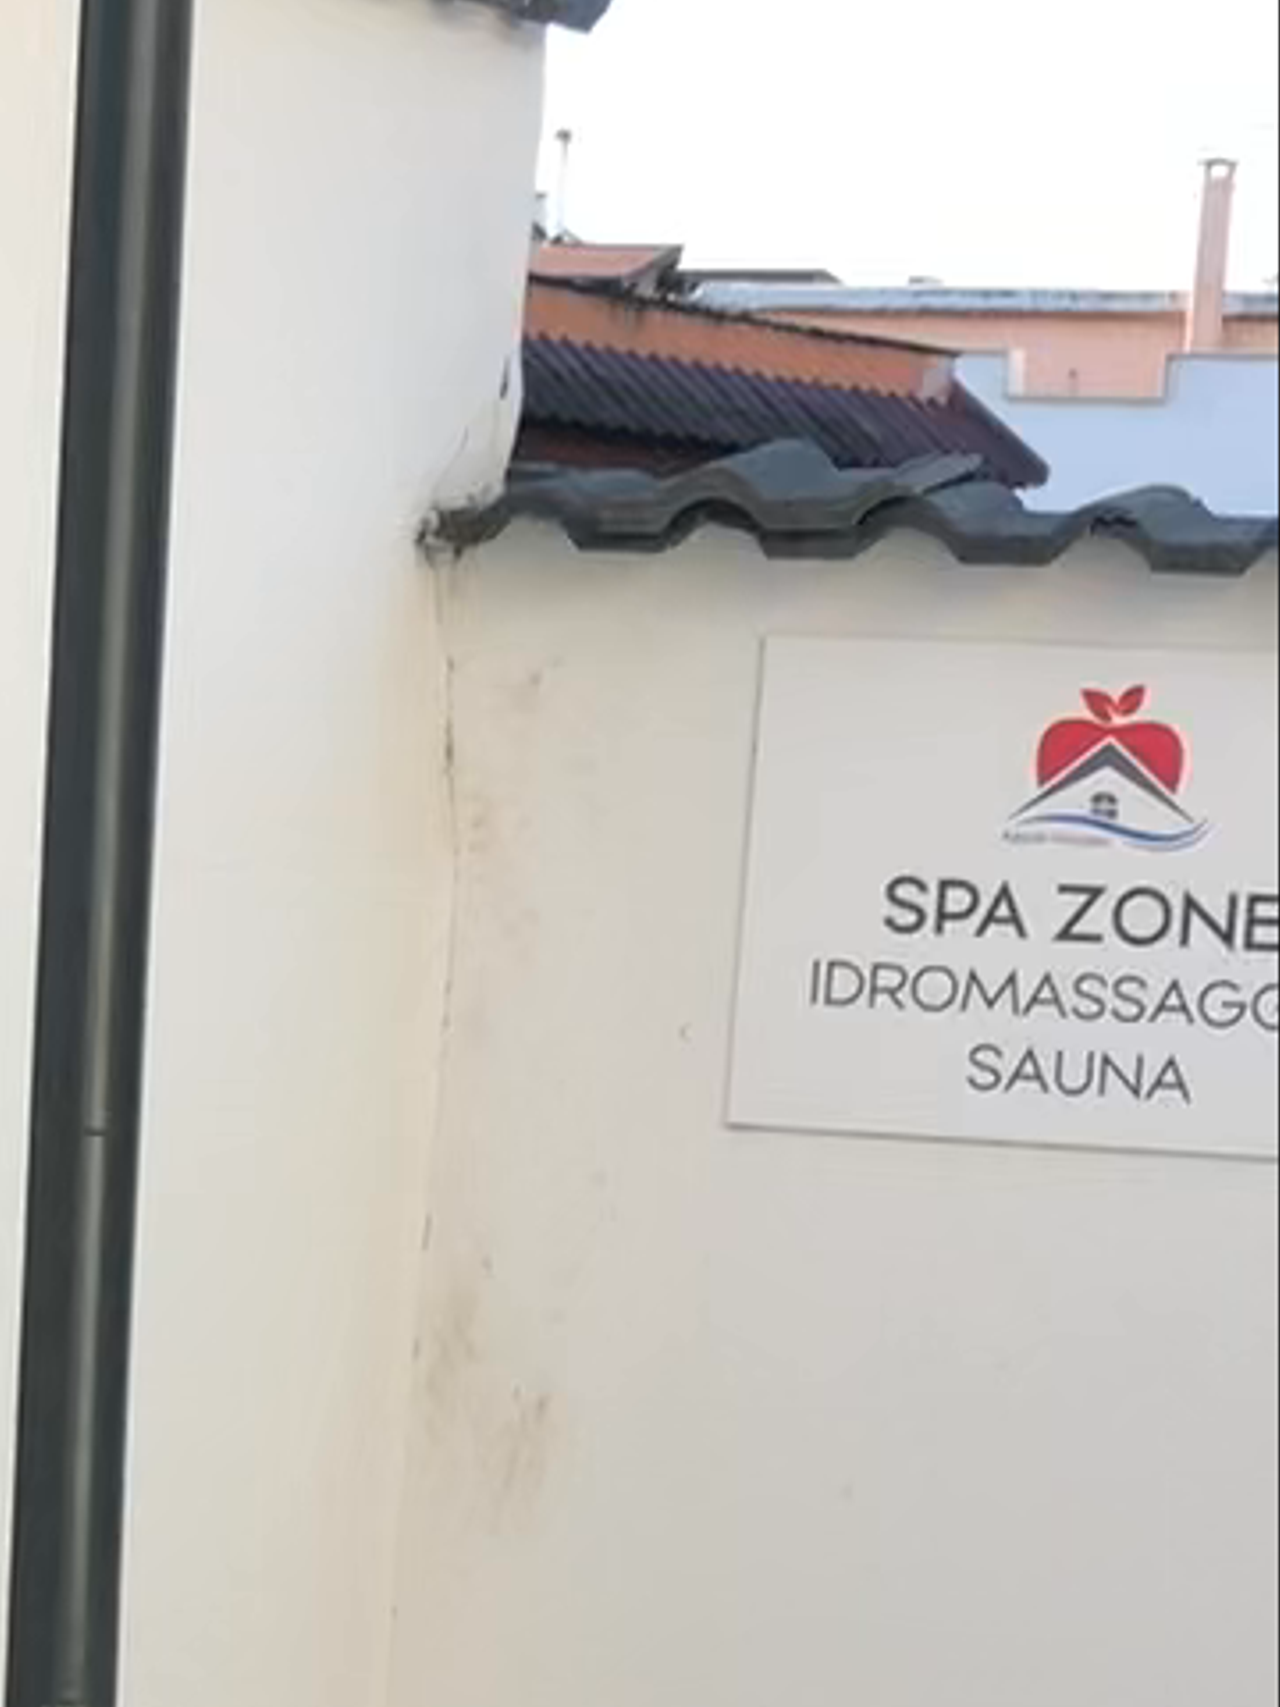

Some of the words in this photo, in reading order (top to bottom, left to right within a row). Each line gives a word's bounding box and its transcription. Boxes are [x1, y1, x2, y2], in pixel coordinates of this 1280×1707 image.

[884, 875, 1028, 940] SPA
[1052, 883, 1278, 953] ZONE
[966, 1043, 1192, 1105] SAUNA
